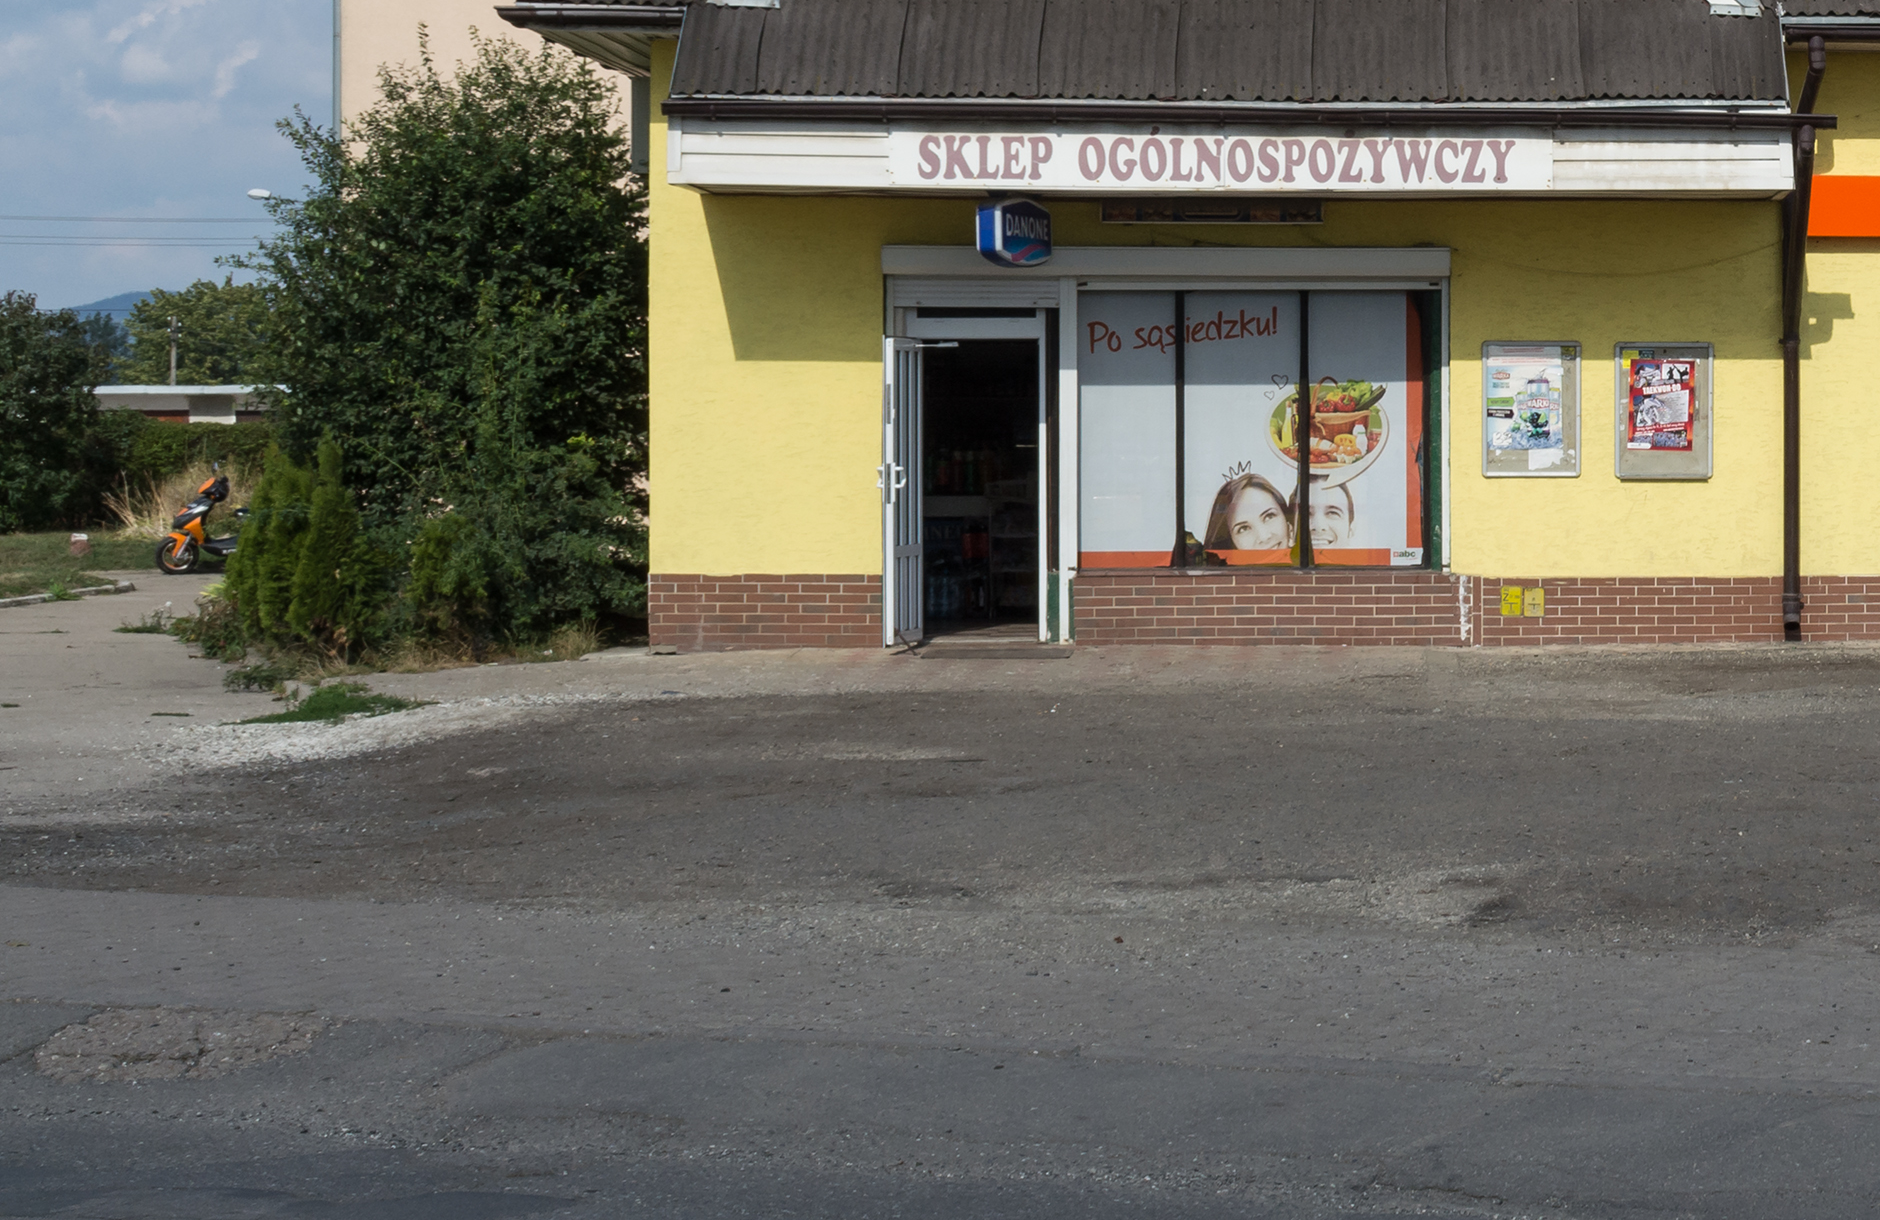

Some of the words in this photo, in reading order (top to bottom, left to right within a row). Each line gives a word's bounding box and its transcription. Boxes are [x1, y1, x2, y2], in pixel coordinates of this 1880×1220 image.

[917, 135, 1053, 180] SKLEP
[1006, 213, 1049, 241] DANONE
[1087, 321, 1122, 354] Po
[1133, 306, 1277, 354] sąsiedzku!
[1643, 383, 1681, 395] TAEKWON-DO
[1398, 550, 1416, 558] abc
